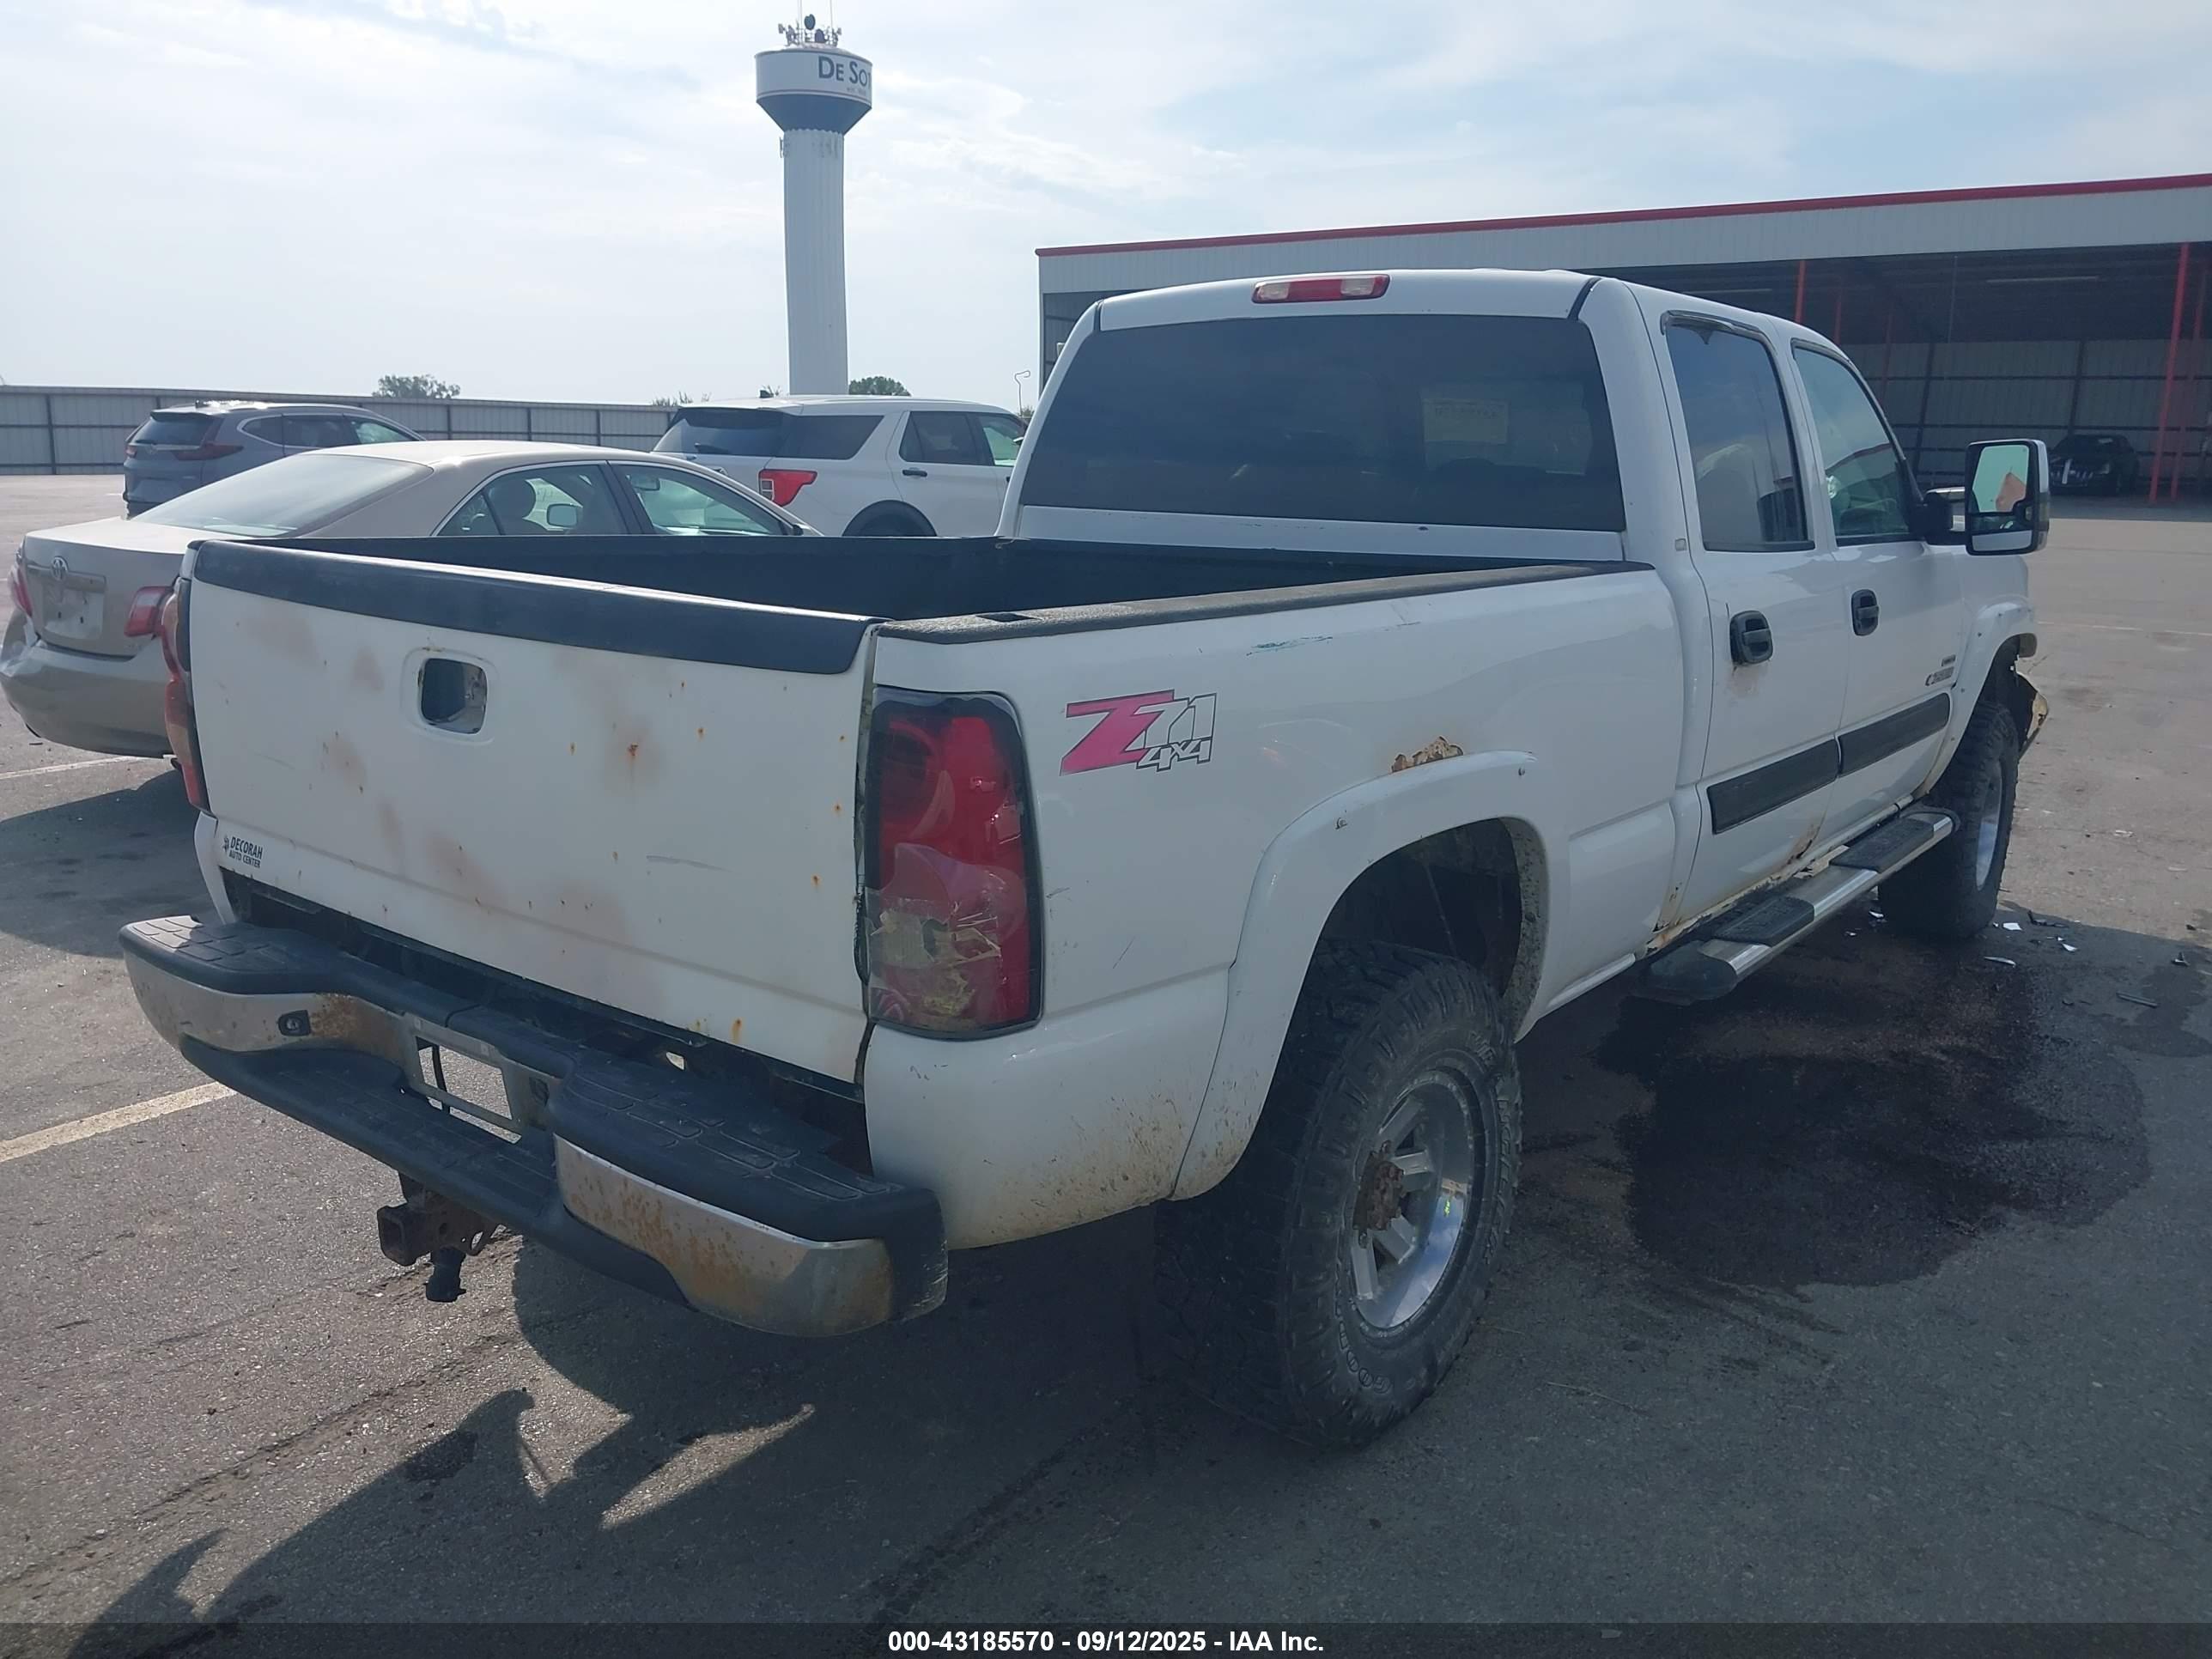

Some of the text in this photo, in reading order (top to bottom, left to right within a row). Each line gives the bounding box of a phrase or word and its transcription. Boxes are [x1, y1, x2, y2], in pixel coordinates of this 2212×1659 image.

[1060, 689, 1217, 776] Z71
[230, 836, 263, 860] DECORAH
[242, 854, 261, 869] CENTER
